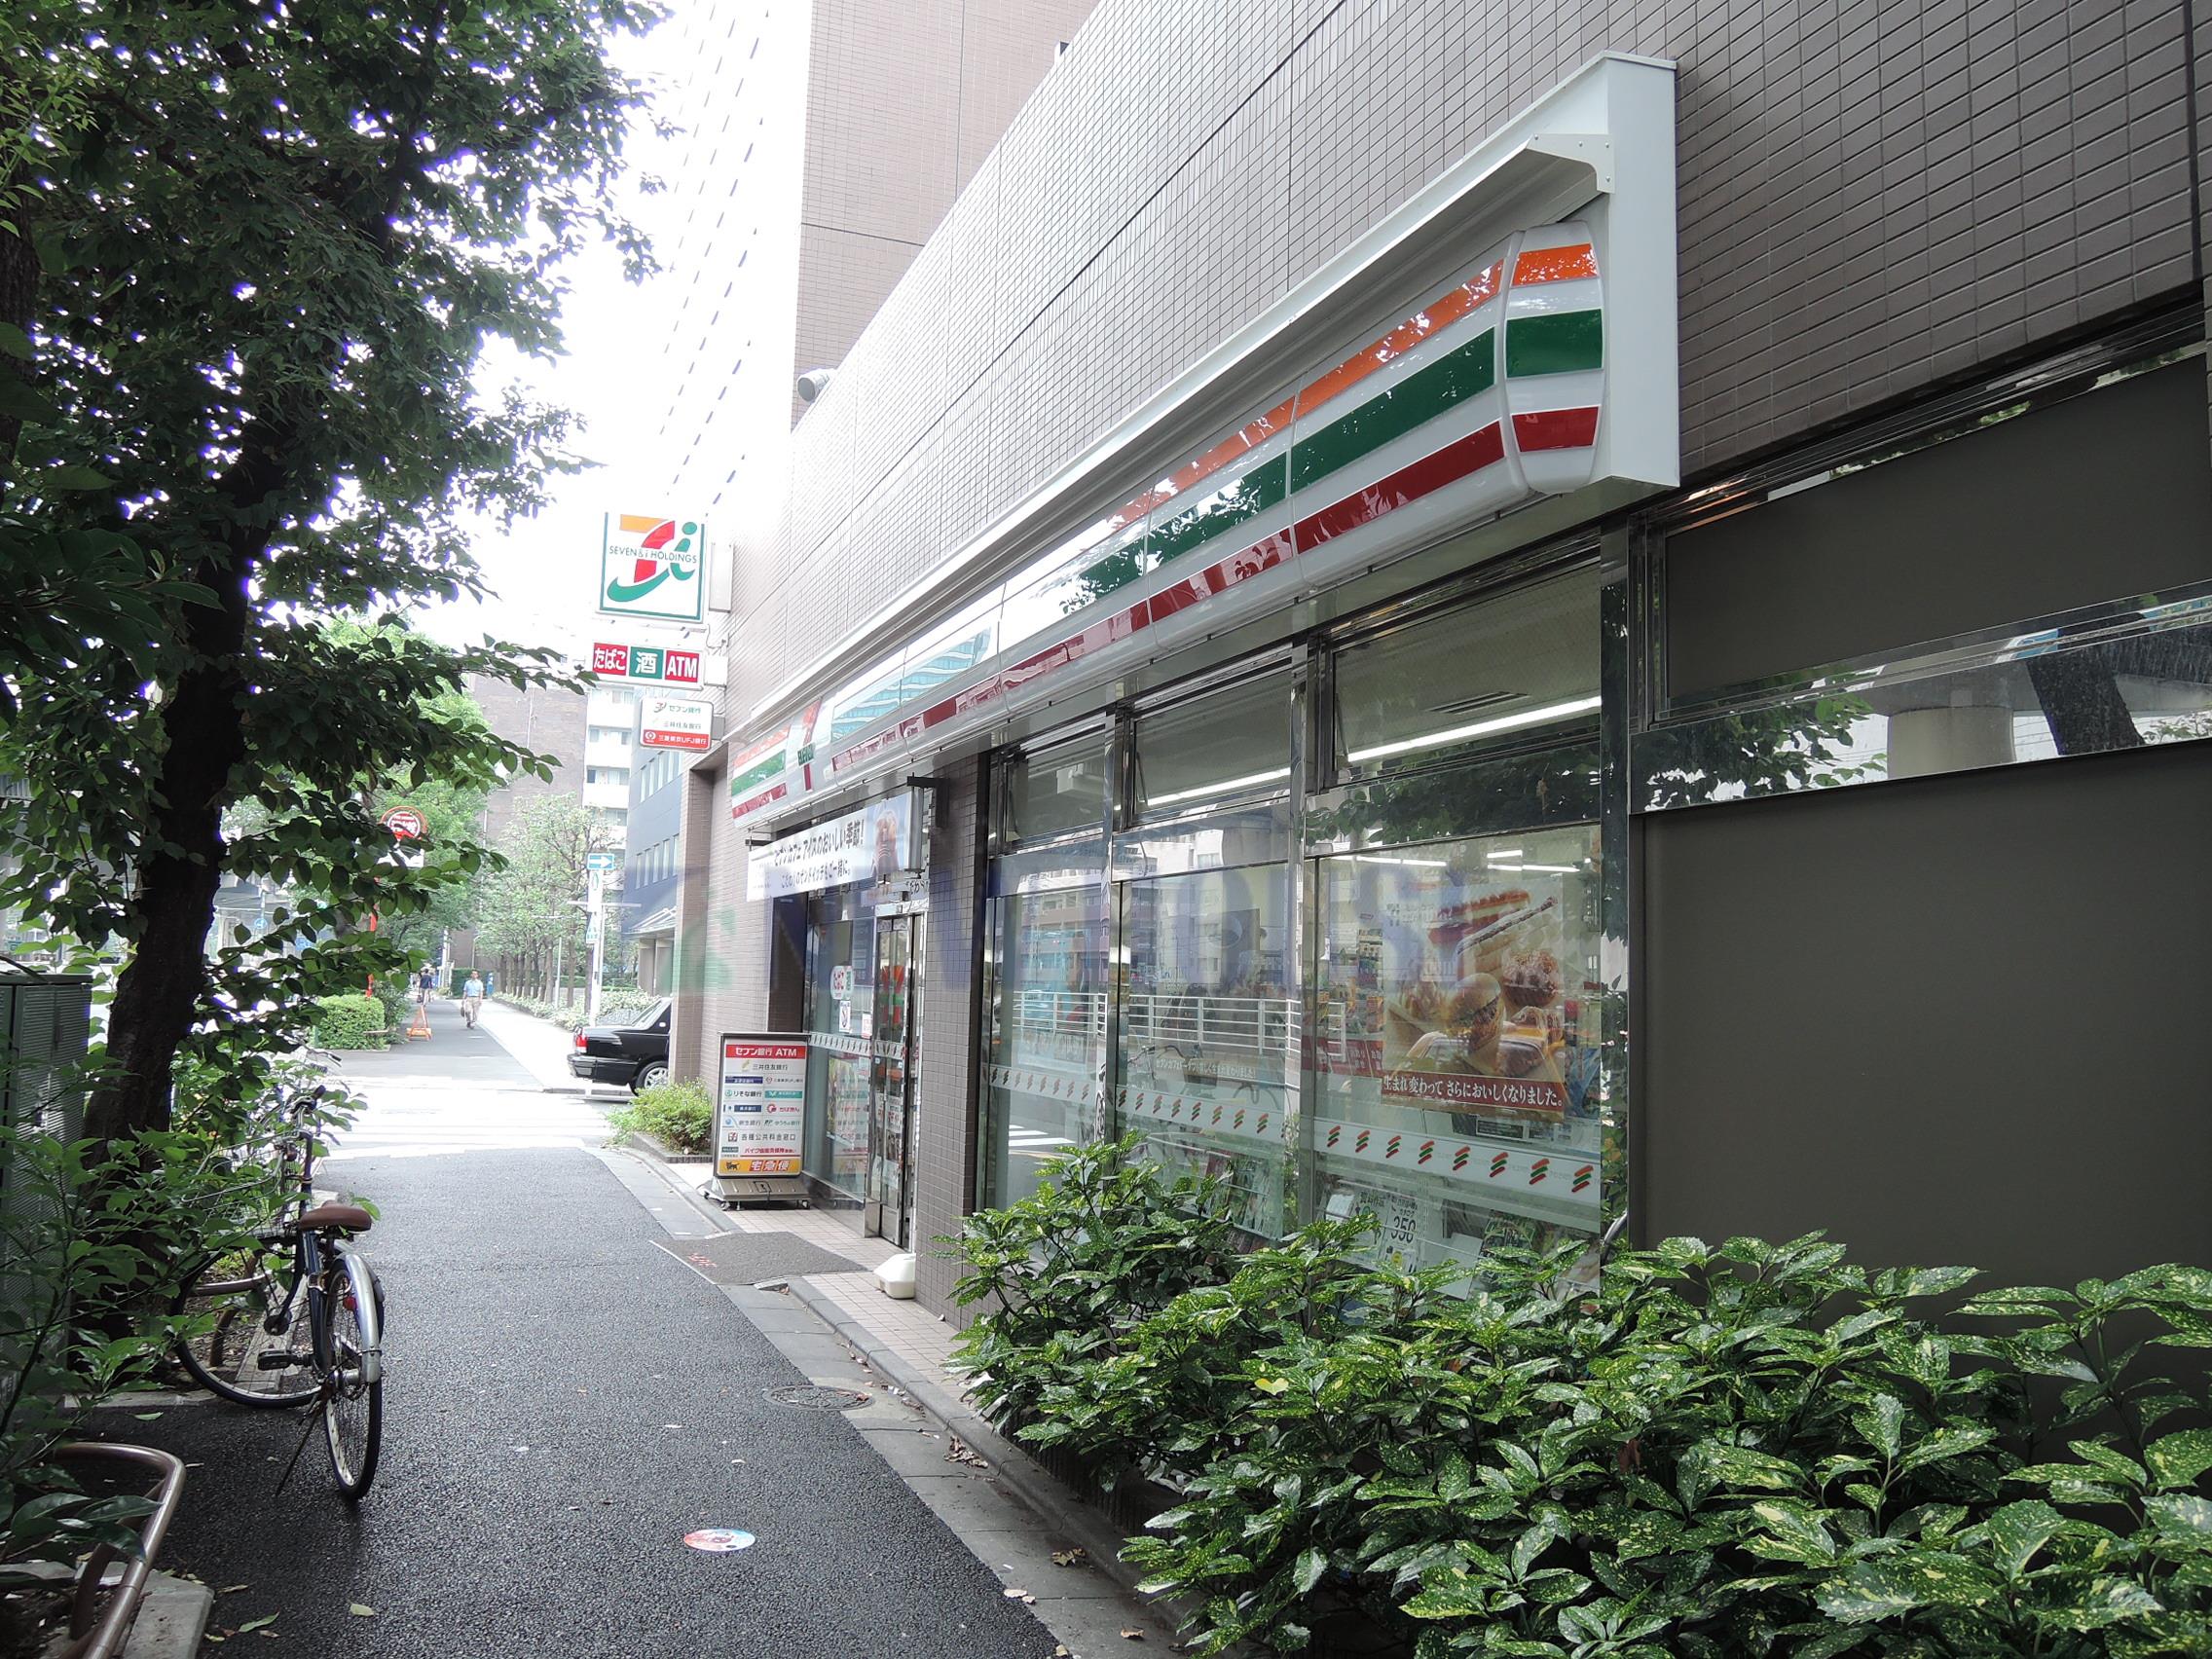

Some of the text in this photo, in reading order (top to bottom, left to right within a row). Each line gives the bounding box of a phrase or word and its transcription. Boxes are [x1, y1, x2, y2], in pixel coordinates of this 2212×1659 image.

[650, 550, 697, 564] HOLDINGS
[593, 646, 698, 679] たばこ 酒 ATM
[735, 1047, 797, 1056] セブン銀行 ATM
[1382, 1074, 1563, 1107] 生まれ変わって さらにおいしくなりました。
[751, 1160, 790, 1171] 宅急便
